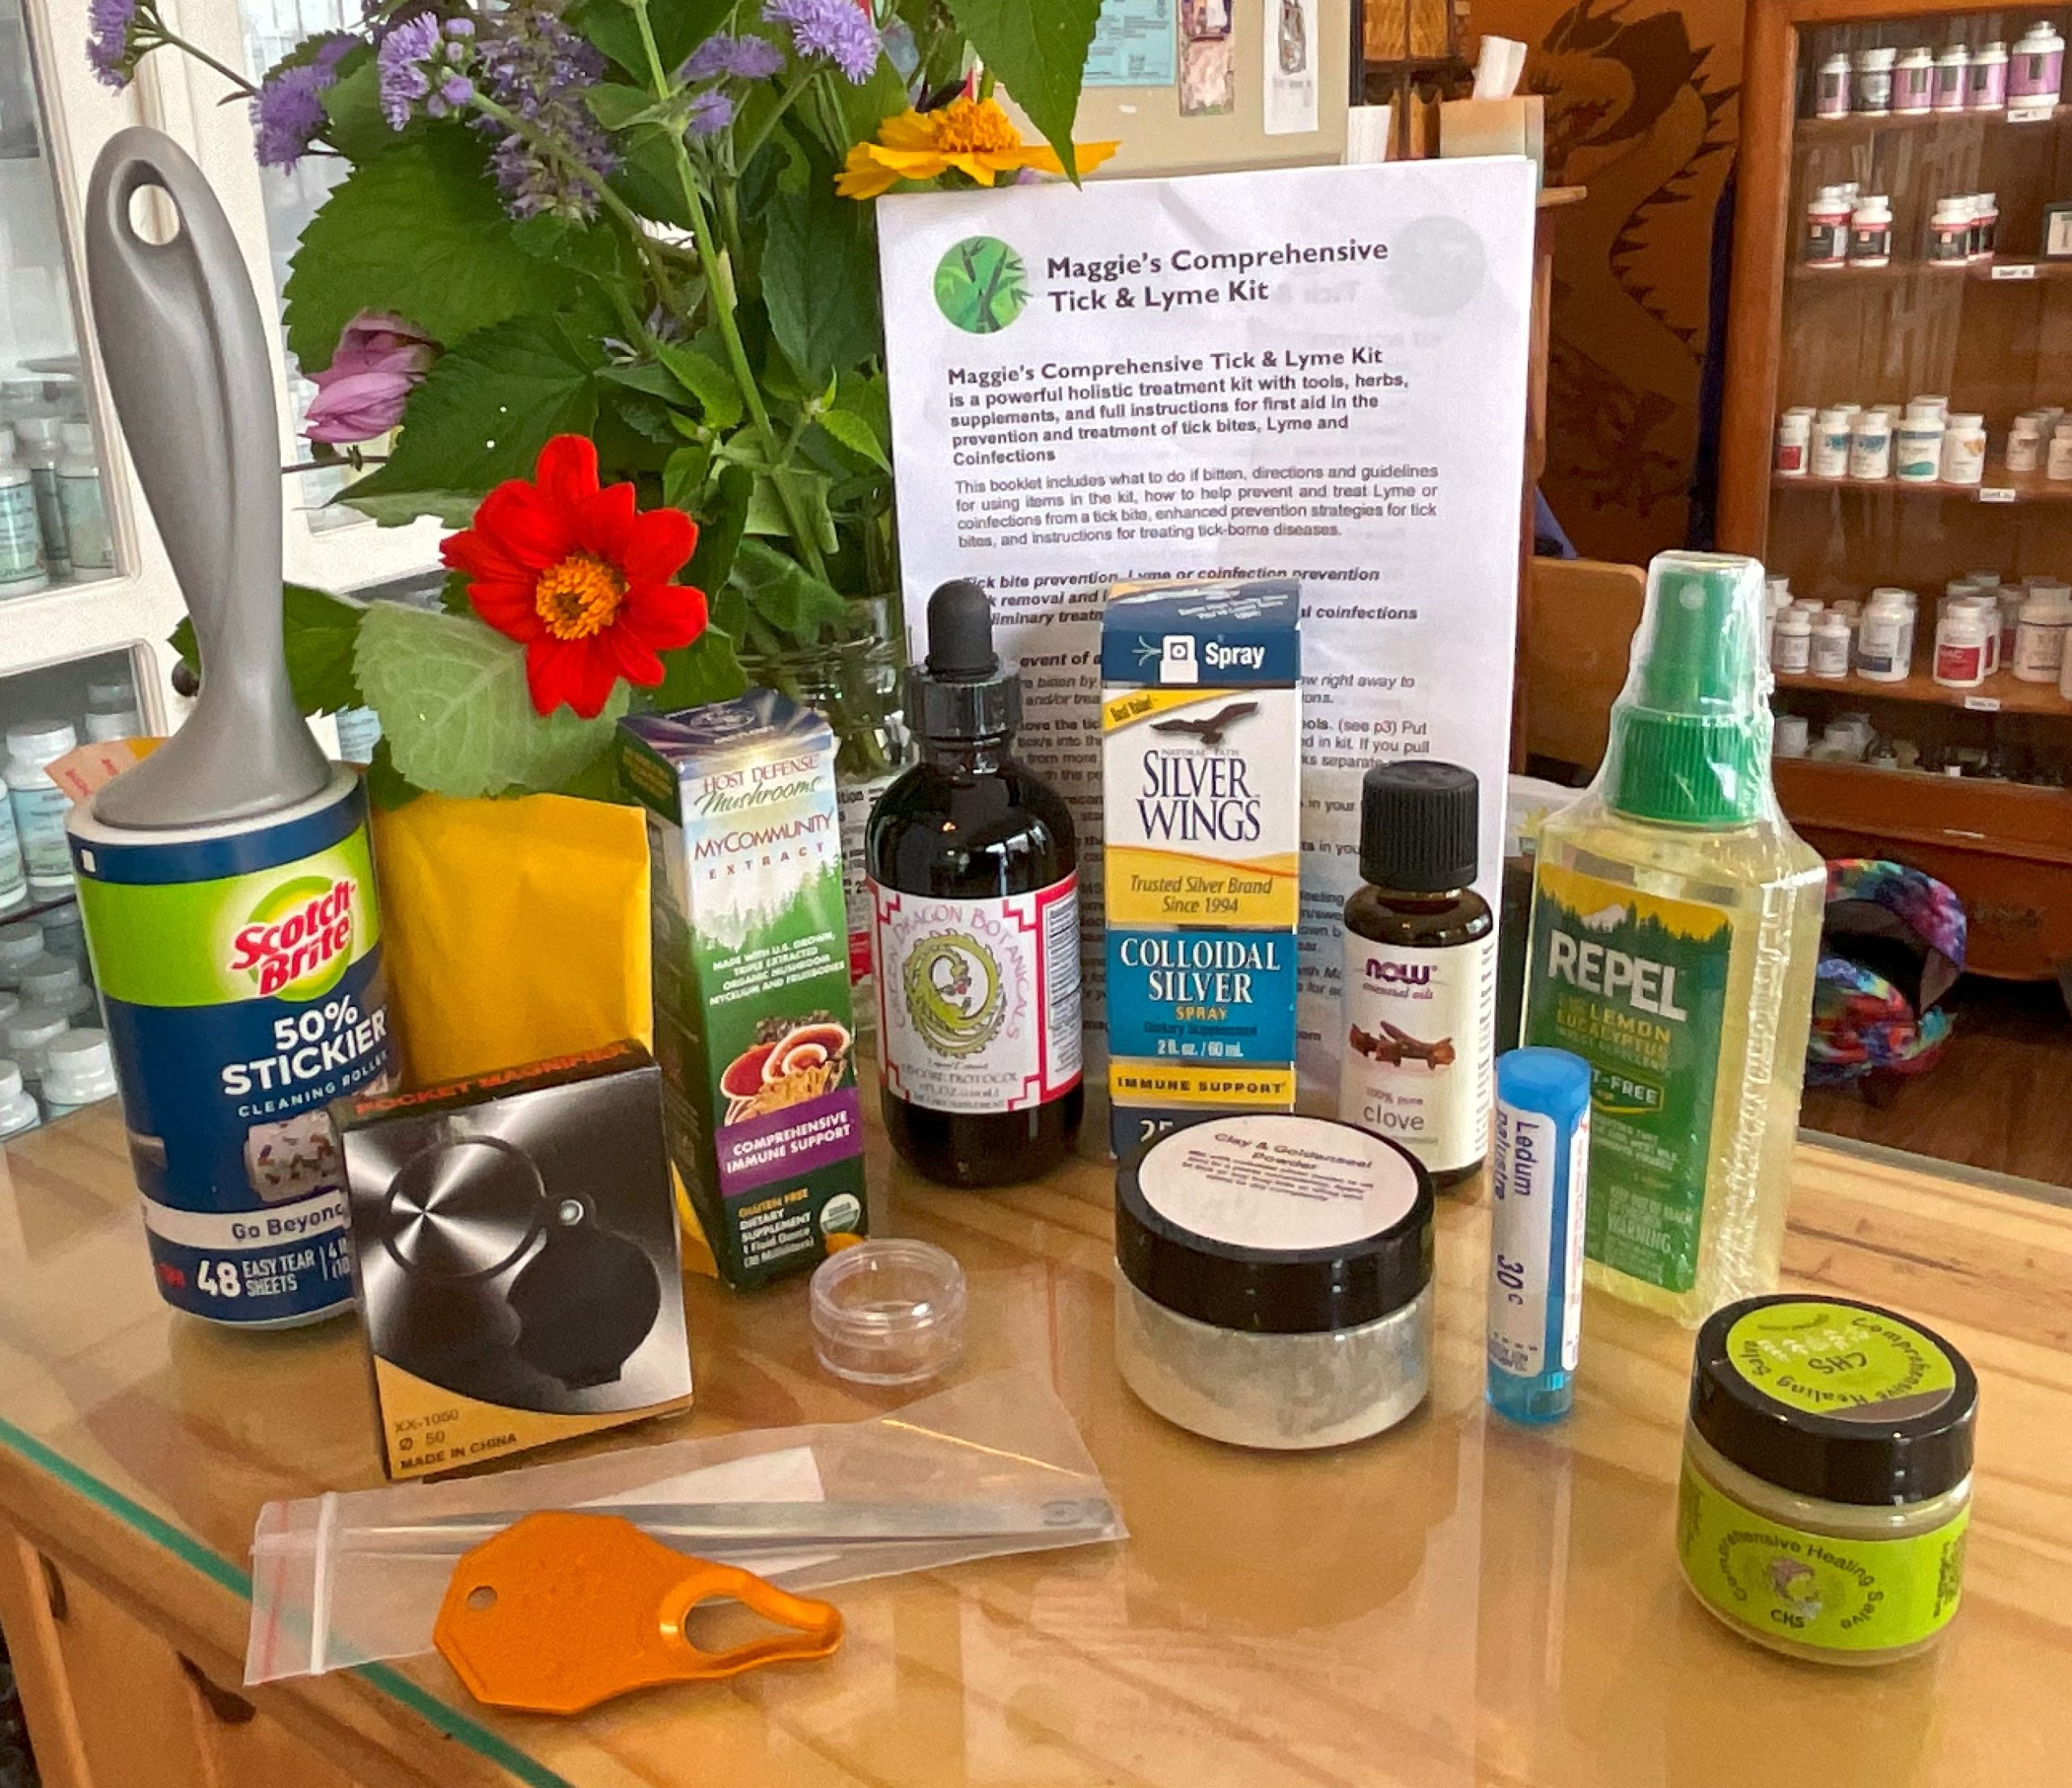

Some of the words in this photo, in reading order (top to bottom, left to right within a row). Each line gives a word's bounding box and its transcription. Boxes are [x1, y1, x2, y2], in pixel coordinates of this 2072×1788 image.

[1047, 252, 1161, 282] Maggie's
[1170, 238, 1388, 274] Comprehensive
[1047, 288, 1106, 312] Tick
[1115, 287, 1135, 308] &
[1144, 283, 1220, 312] Lyme
[1229, 279, 1268, 302] Kit
[948, 364, 1034, 388] Maggie's
[1041, 354, 1203, 380] Comprehensive
[1210, 350, 1255, 370] Tick
[1262, 350, 1277, 367] &
[1285, 350, 1344, 370] Lyme
[1352, 346, 1383, 364] Kit
[949, 392, 964, 407] is
[970, 394, 980, 406] a
[986, 387, 1063, 409] powerful
[1068, 382, 1132, 401] holistic
[1140, 377, 1225, 397] treatment
[1231, 376, 1252, 392] kit
[1258, 374, 1296, 390] with
[1302, 373, 1349, 391] tools,
[1355, 372, 1408, 389] herbs,
[950, 409, 1059, 430] supplements,
[1065, 406, 1095, 422] and
[1099, 405, 1125, 418] full
[1131, 400, 1229, 418] instructions
[1234, 397, 1258, 412] for
[1263, 396, 1296, 410] first
[1300, 395, 1326, 409] aid
[1331, 395, 1346, 409] in
[1352, 393, 1378, 409] the
[953, 430, 1038, 449] prevention
[1042, 426, 1073, 442] and
[1078, 423, 1157, 440] treatment
[1161, 421, 1178, 435] of
[1182, 418, 1212, 434] tick
[1216, 417, 1261, 434] bites,
[1267, 416, 1312, 433] Lyme
[1318, 414, 1348, 431] and
[953, 448, 1055, 466] Coinfections
[955, 479, 985, 494] This
[990, 477, 1042, 492] booklet
[1047, 474, 1106, 490] includes
[1110, 472, 1144, 486] what
[1149, 471, 1161, 484] to
[1167, 469, 1184, 483] do
[1190, 467, 1201, 482] if
[1203, 467, 1246, 482] bitten,
[1252, 465, 1323, 479] directions
[1327, 465, 1356, 478] and
[1361, 464, 1438, 481] guidelines
[956, 499, 974, 512] for
[981, 497, 1020, 512] using
[1025, 495, 1064, 508] items
[1070, 493, 1083, 507] in
[1089, 491, 1111, 505] the
[1144, 489, 1174, 503] how
[1181, 487, 1194, 500] to
[1201, 486, 1232, 502] help
[1238, 485, 1293, 501] prevent
[1299, 484, 1327, 498] and
[1333, 484, 1367, 498] treat
[1374, 483, 1416, 500] Lyme
[1422, 485, 1438, 497] or
[957, 513, 1042, 531] coinfections
[1046, 512, 1076, 525] from
[1081, 512, 1089, 525] a
[1094, 509, 1118, 523] tick
[1122, 508, 1152, 523] bite,
[1156, 504, 1227, 520] enhanced
[1231, 503, 1306, 520] prevention
[1311, 502, 1382, 520] strategies
[1387, 502, 1406, 516] for
[1411, 502, 1437, 516] tick
[959, 535, 996, 549] bites,
[1000, 532, 1027, 546] and
[1032, 527, 1112, 545] instructions
[1117, 525, 1136, 541] for
[1140, 524, 1193, 541] treating
[1199, 523, 1269, 537] tick-borne
[1273, 522, 1342, 537] diseases.
[1000, 575, 1029, 589] bite
[1001, 591, 1064, 606] removal
[1068, 589, 1098, 604] and
[1316, 605, 1418, 620] coinfections
[1205, 642, 1265, 669] Spray
[703, 771, 745, 794] HOST
[751, 756, 819, 784] DEFENSE
[1143, 750, 1252, 798] SILVER
[694, 776, 821, 816] Mushrooms
[1136, 798, 1261, 842] WINGS
[709, 842, 825, 880] EXTRACT
[1132, 874, 1182, 892] Trusted
[1186, 875, 1225, 894] Silver
[1228, 877, 1274, 894] Brand
[1162, 895, 1199, 913] Since
[1205, 897, 1239, 914] 1994
[259, 915, 350, 997] Brite
[1120, 937, 1280, 971] COLLOIDAL
[1365, 958, 1429, 985] now
[1148, 969, 1254, 1004] SILVER
[1548, 929, 1688, 1022] REPEL
[274, 994, 359, 1051] 50%
[1176, 1006, 1227, 1020] SPRAY
[1590, 1004, 1671, 1044] LEMON
[221, 1009, 387, 1096] STICKIER
[238, 1081, 337, 1118] CLEANING
[1117, 1077, 1191, 1091] IMMUNE
[1198, 1081, 1282, 1094] SUPPORT
[1592, 1068, 1659, 1106] T-FREE
[732, 1110, 848, 1157] COMPREHENSIVE
[1363, 1103, 1424, 1132] clove
[725, 1146, 786, 1174] IMMUNE
[791, 1123, 851, 1154] SUPPORT
[1214, 1132, 1252, 1148] Clay
[1273, 1145, 1372, 1169] Goldenseal
[1252, 1152, 1318, 1170] Powder
[1514, 1121, 1540, 1196] Ledum
[231, 1222, 261, 1241] Go
[197, 1259, 242, 1298] 48
[243, 1257, 277, 1278] EASY
[281, 1249, 316, 1272] TEAR
[245, 1276, 298, 1297] SHEETS
[1807, 1351, 1867, 1375] CHS
[1777, 1374, 1870, 1406] Healing
[400, 1449, 448, 1471] MADE
[450, 1445, 466, 1459] IN
[469, 1433, 518, 1455] CHINA
[426, 1429, 446, 1446] 50
[1807, 1543, 1875, 1587] Healing
[1770, 1608, 1806, 1629] CHS
[1839, 1590, 1884, 1629] Salve
